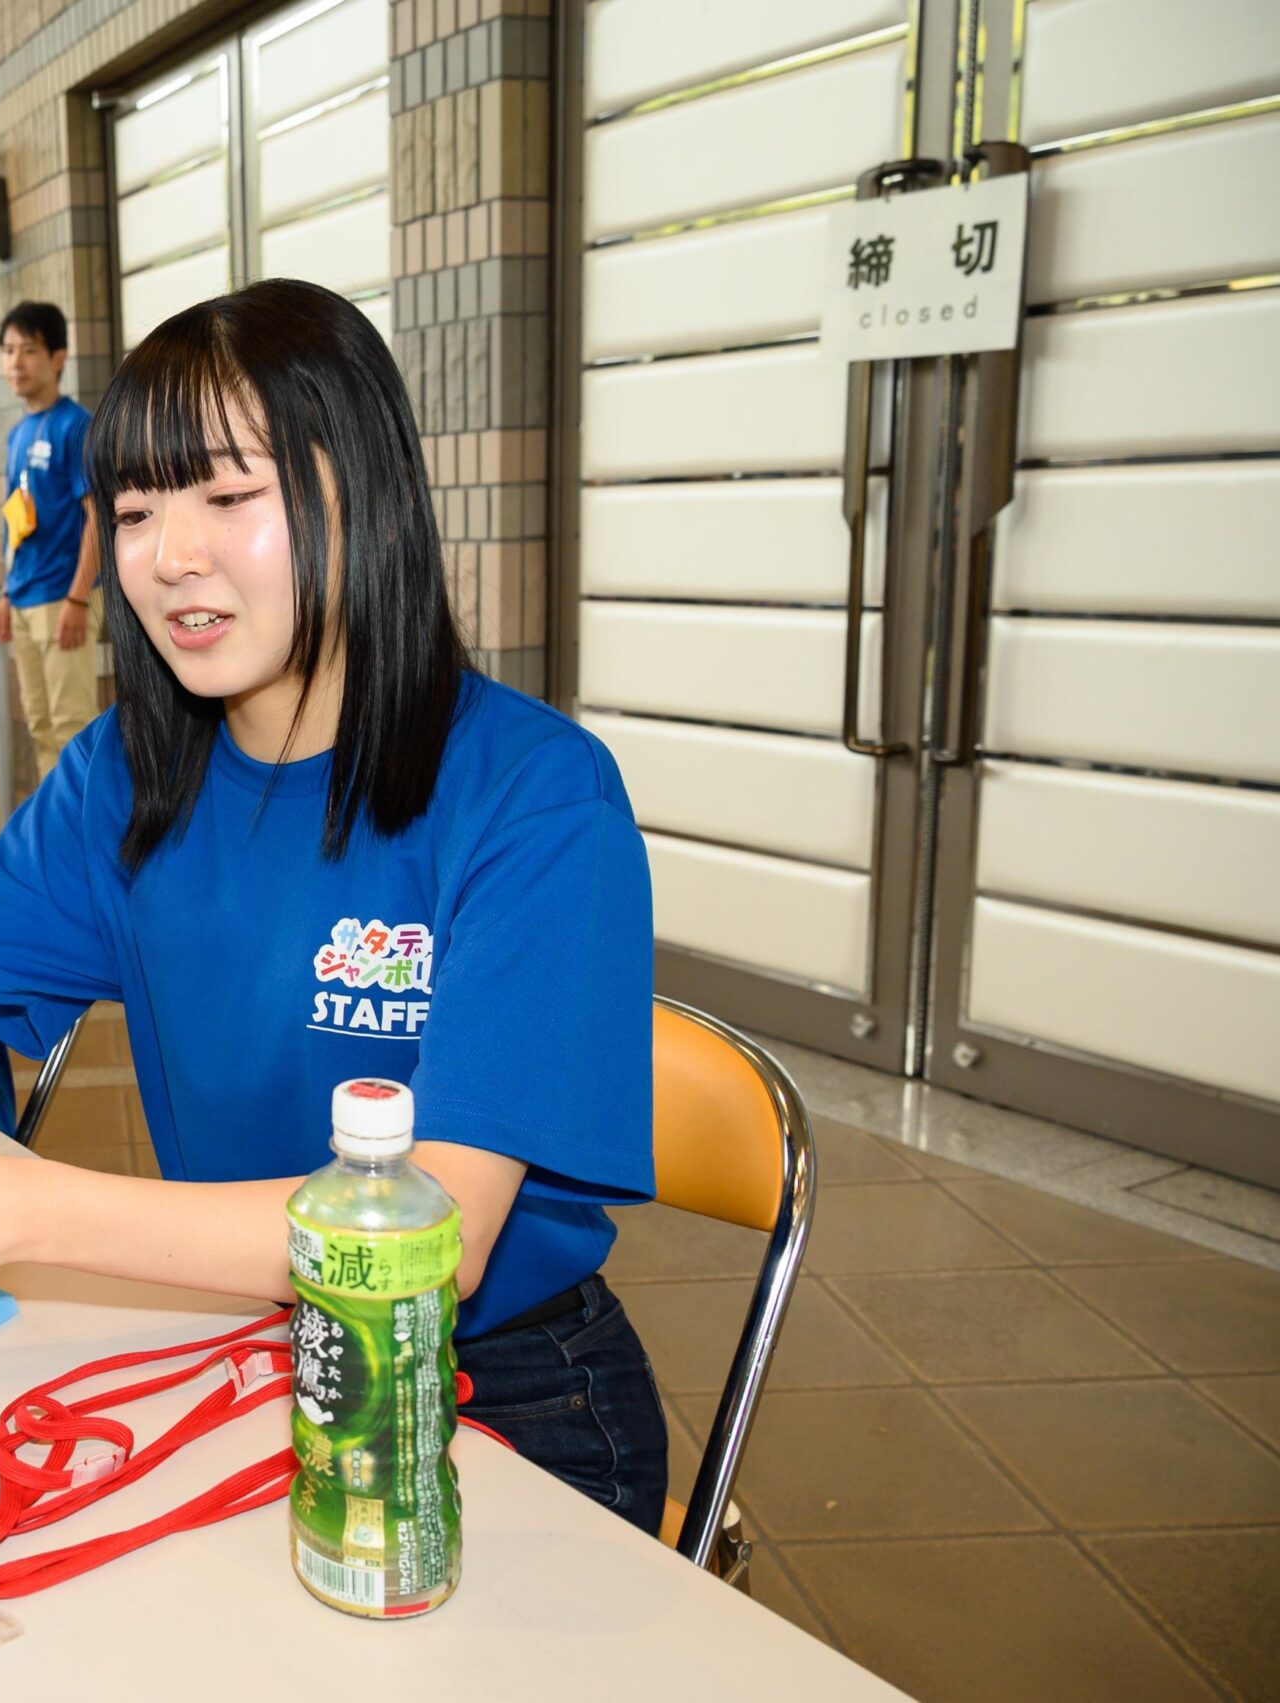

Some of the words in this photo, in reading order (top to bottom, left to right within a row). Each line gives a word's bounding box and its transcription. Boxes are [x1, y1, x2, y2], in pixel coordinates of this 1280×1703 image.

[847, 220, 999, 291] 締切
[859, 294, 979, 329] closed
[312, 991, 430, 1033] STAFF
[327, 1321, 344, 1400] あやたか
